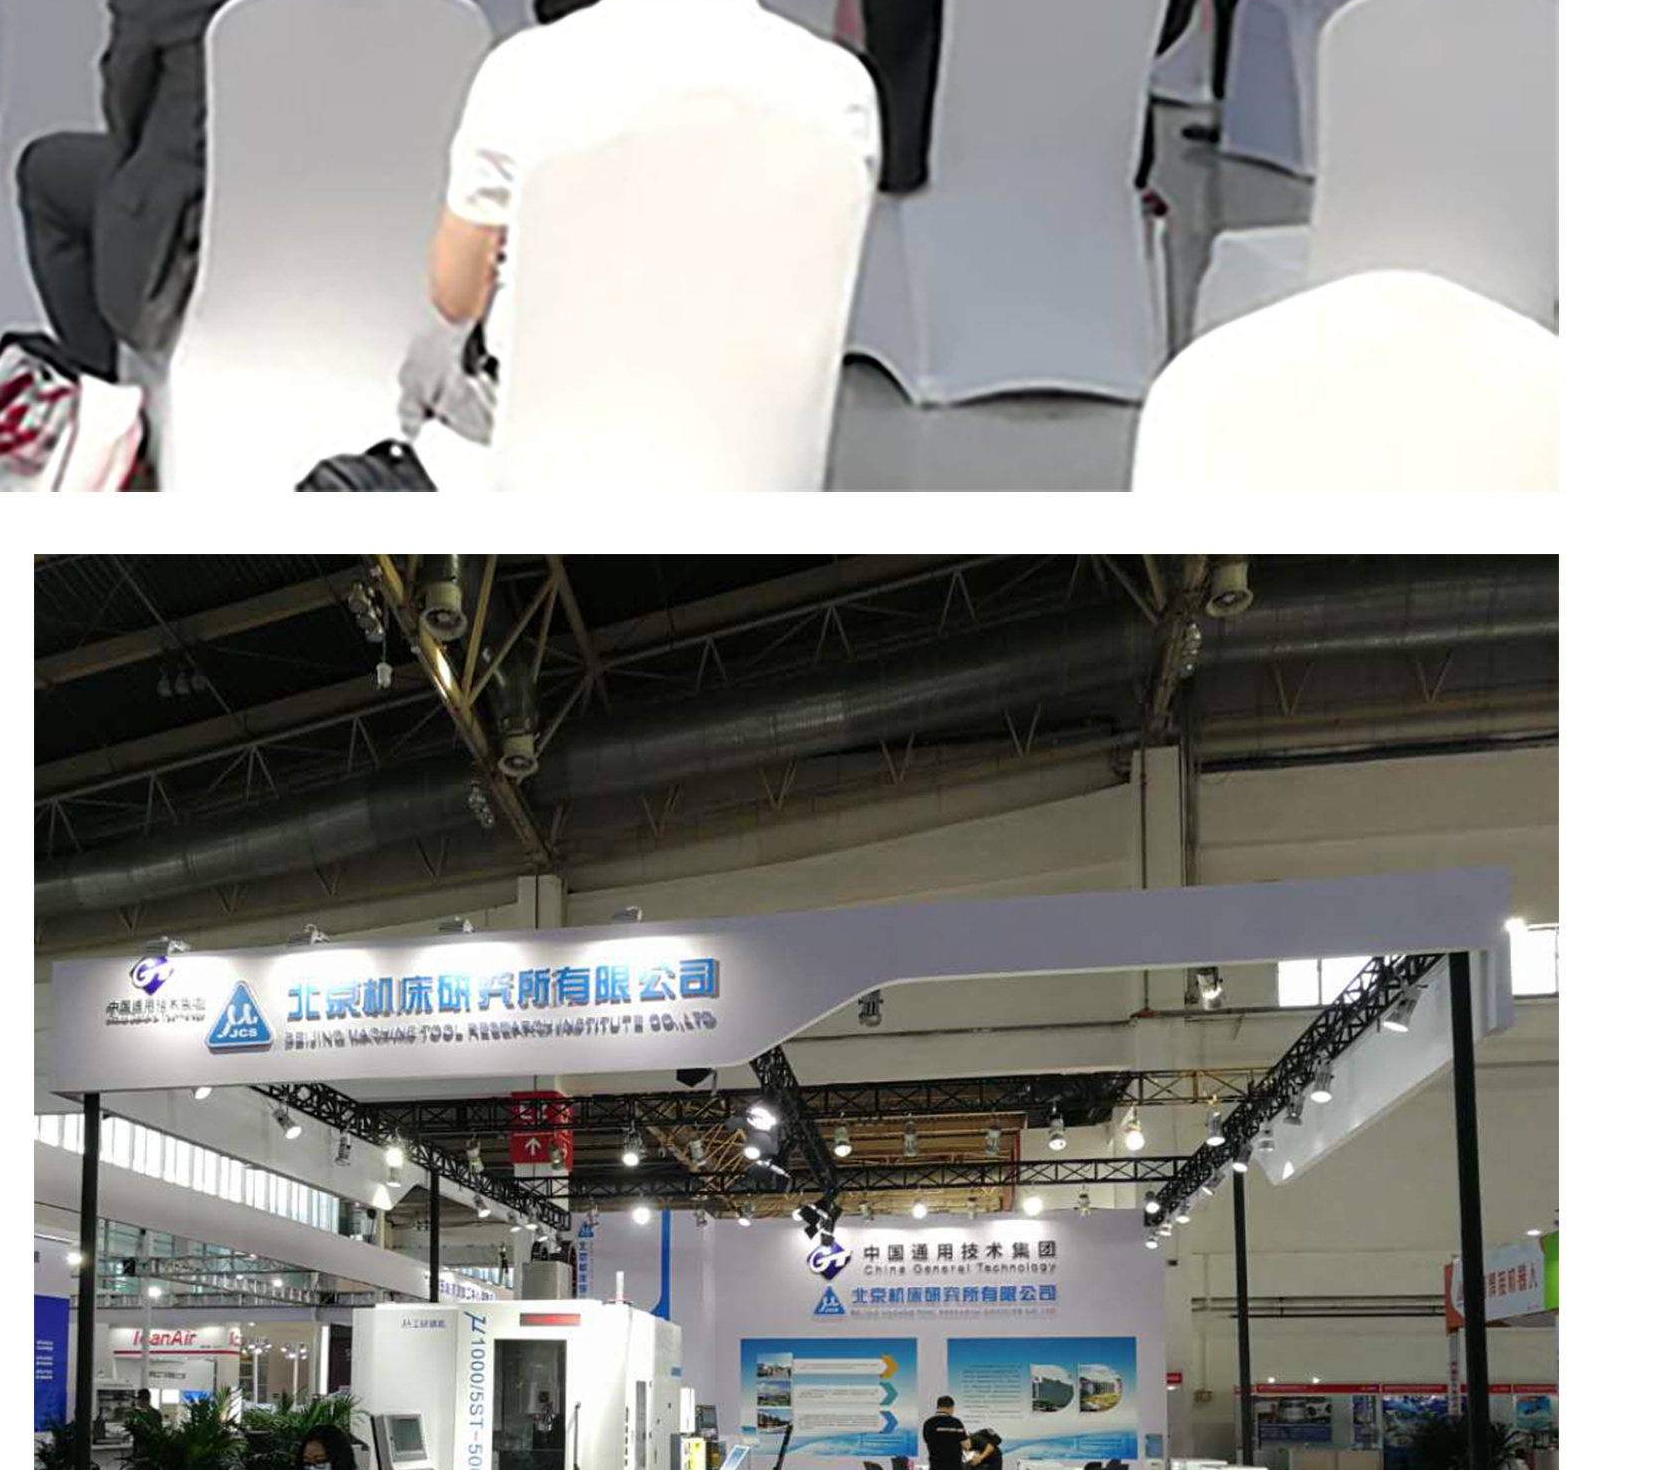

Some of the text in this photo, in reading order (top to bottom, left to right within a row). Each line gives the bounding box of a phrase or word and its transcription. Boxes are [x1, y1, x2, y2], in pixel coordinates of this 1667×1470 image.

[287, 958, 720, 1022] 北京机床研究所有限公司
[863, 1241, 1057, 1261] 中国通用技术集团
[864, 1261, 1057, 1276] China General Technology
[852, 1284, 1057, 1304] 北京机床研究所有限公司
